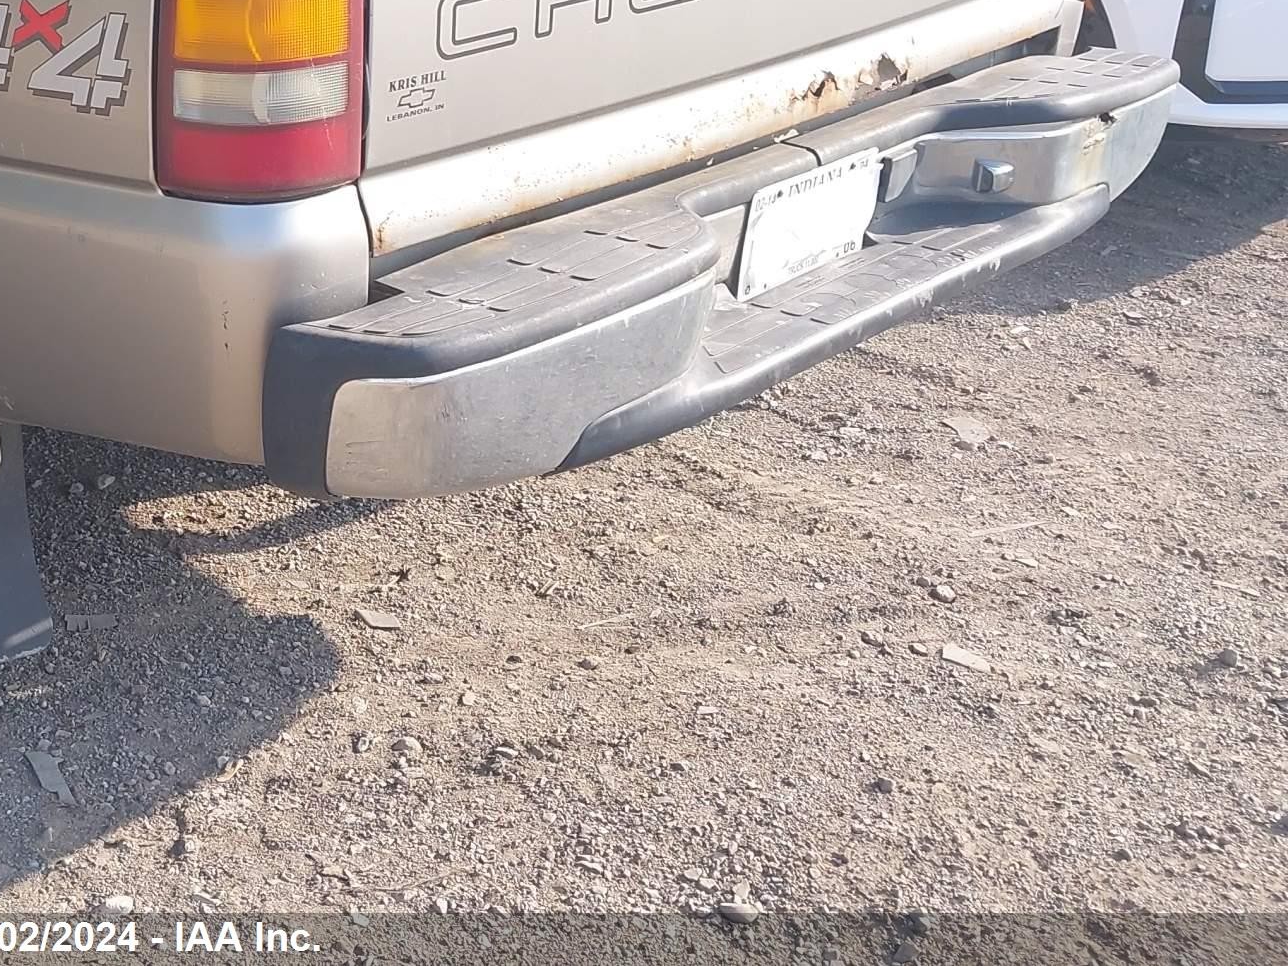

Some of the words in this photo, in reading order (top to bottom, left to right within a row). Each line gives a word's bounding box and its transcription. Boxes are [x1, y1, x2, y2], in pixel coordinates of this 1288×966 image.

[389, 76, 417, 93] KRIS
[420, 70, 447, 85] HILL
[434, 103, 445, 111] IN
[788, 166, 843, 198] INDIANA
